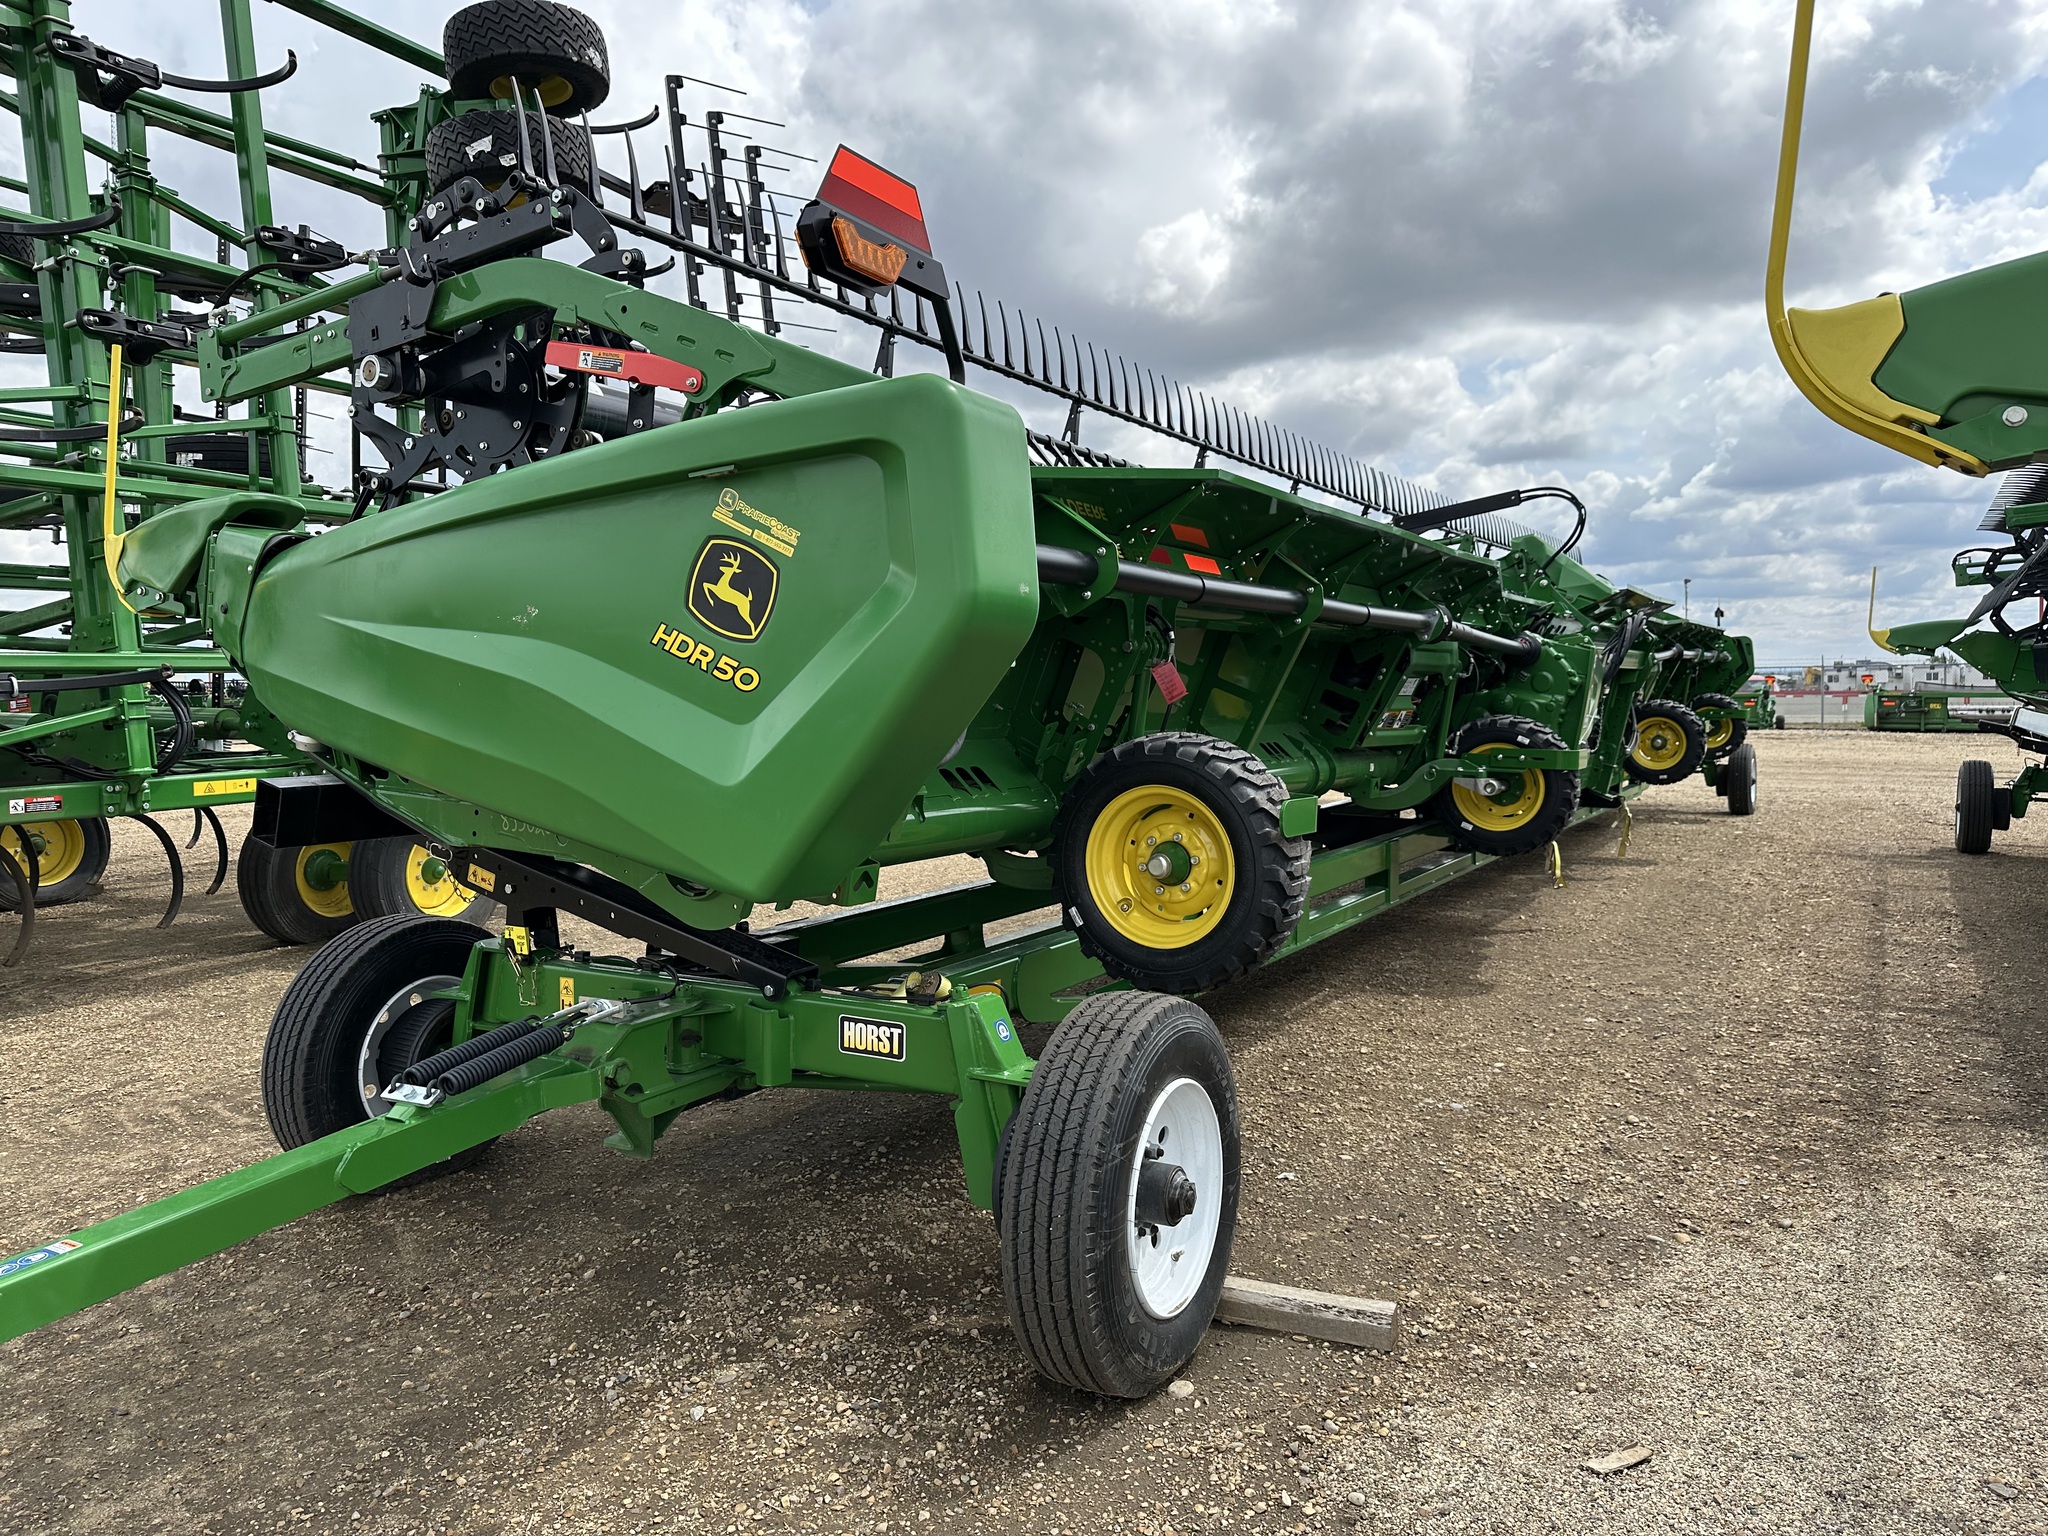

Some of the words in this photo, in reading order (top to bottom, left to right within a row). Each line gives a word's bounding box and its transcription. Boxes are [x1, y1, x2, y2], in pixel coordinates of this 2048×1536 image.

[650, 621, 716, 674] HDR
[711, 653, 762, 692] 50
[843, 1020, 902, 1056] HORST
